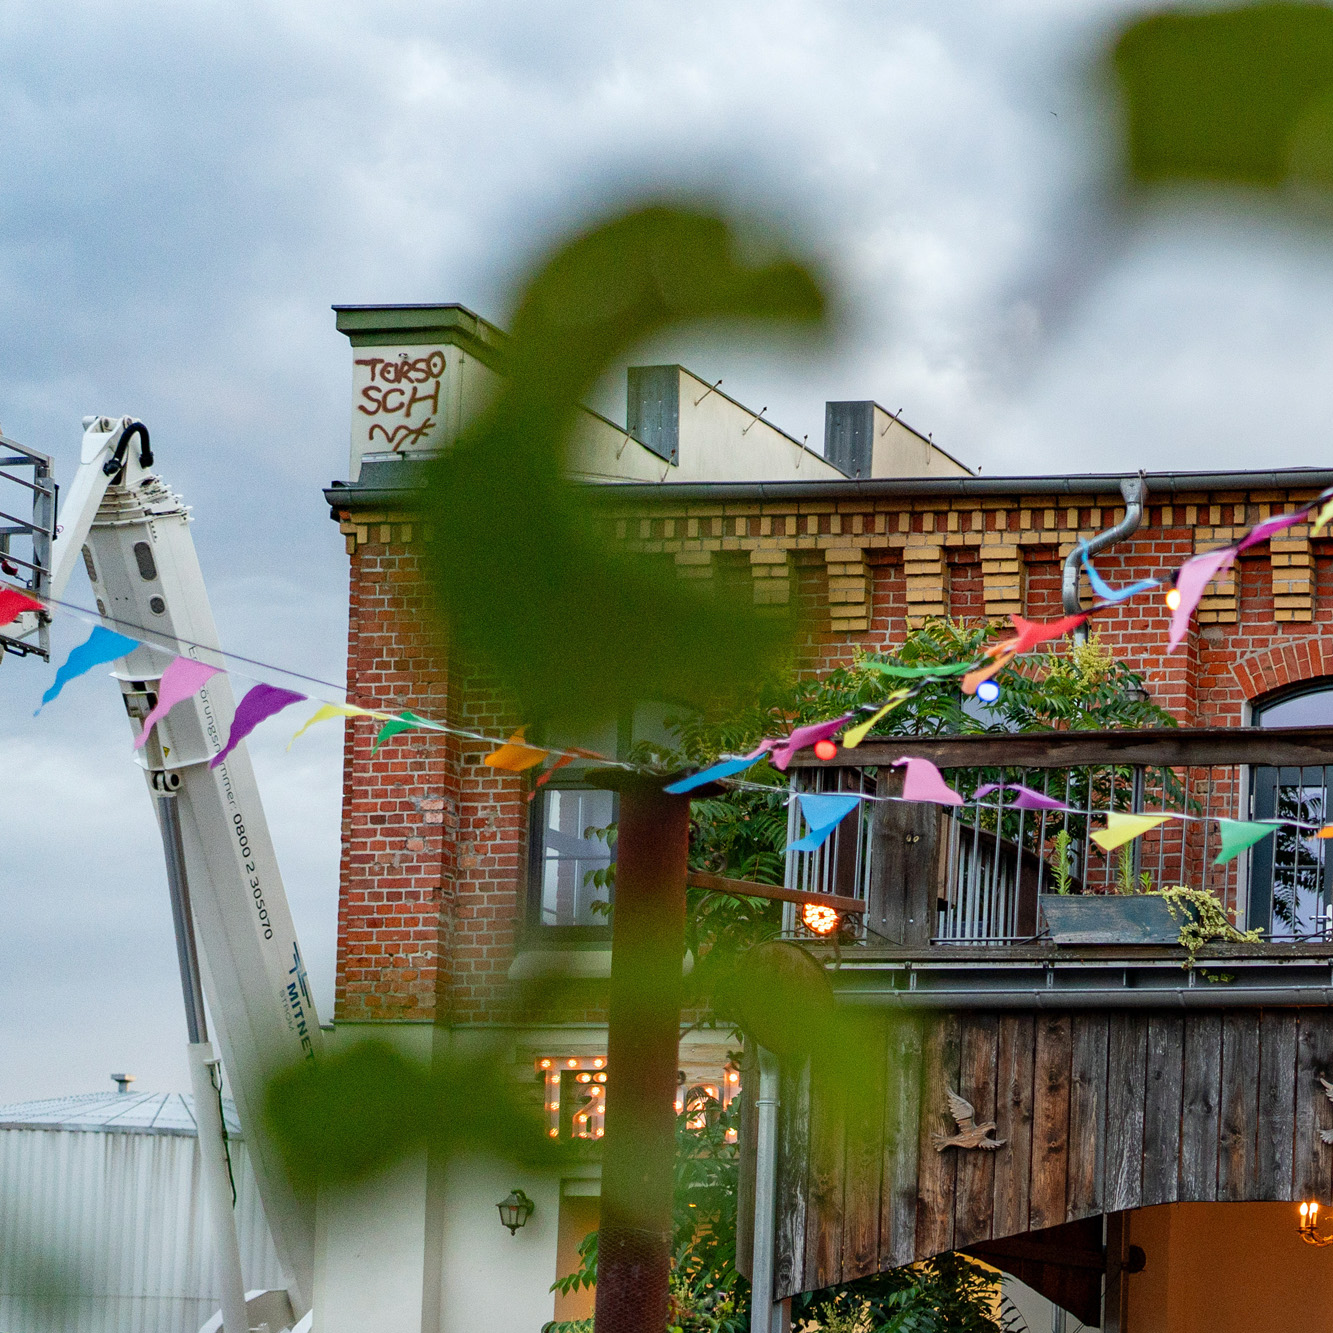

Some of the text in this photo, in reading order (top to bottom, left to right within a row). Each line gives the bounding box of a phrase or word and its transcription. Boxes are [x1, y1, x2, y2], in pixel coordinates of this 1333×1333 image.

[233, 813, 251, 858] 0800
[245, 861, 255, 874] 2
[250, 877, 273, 940] 305070
